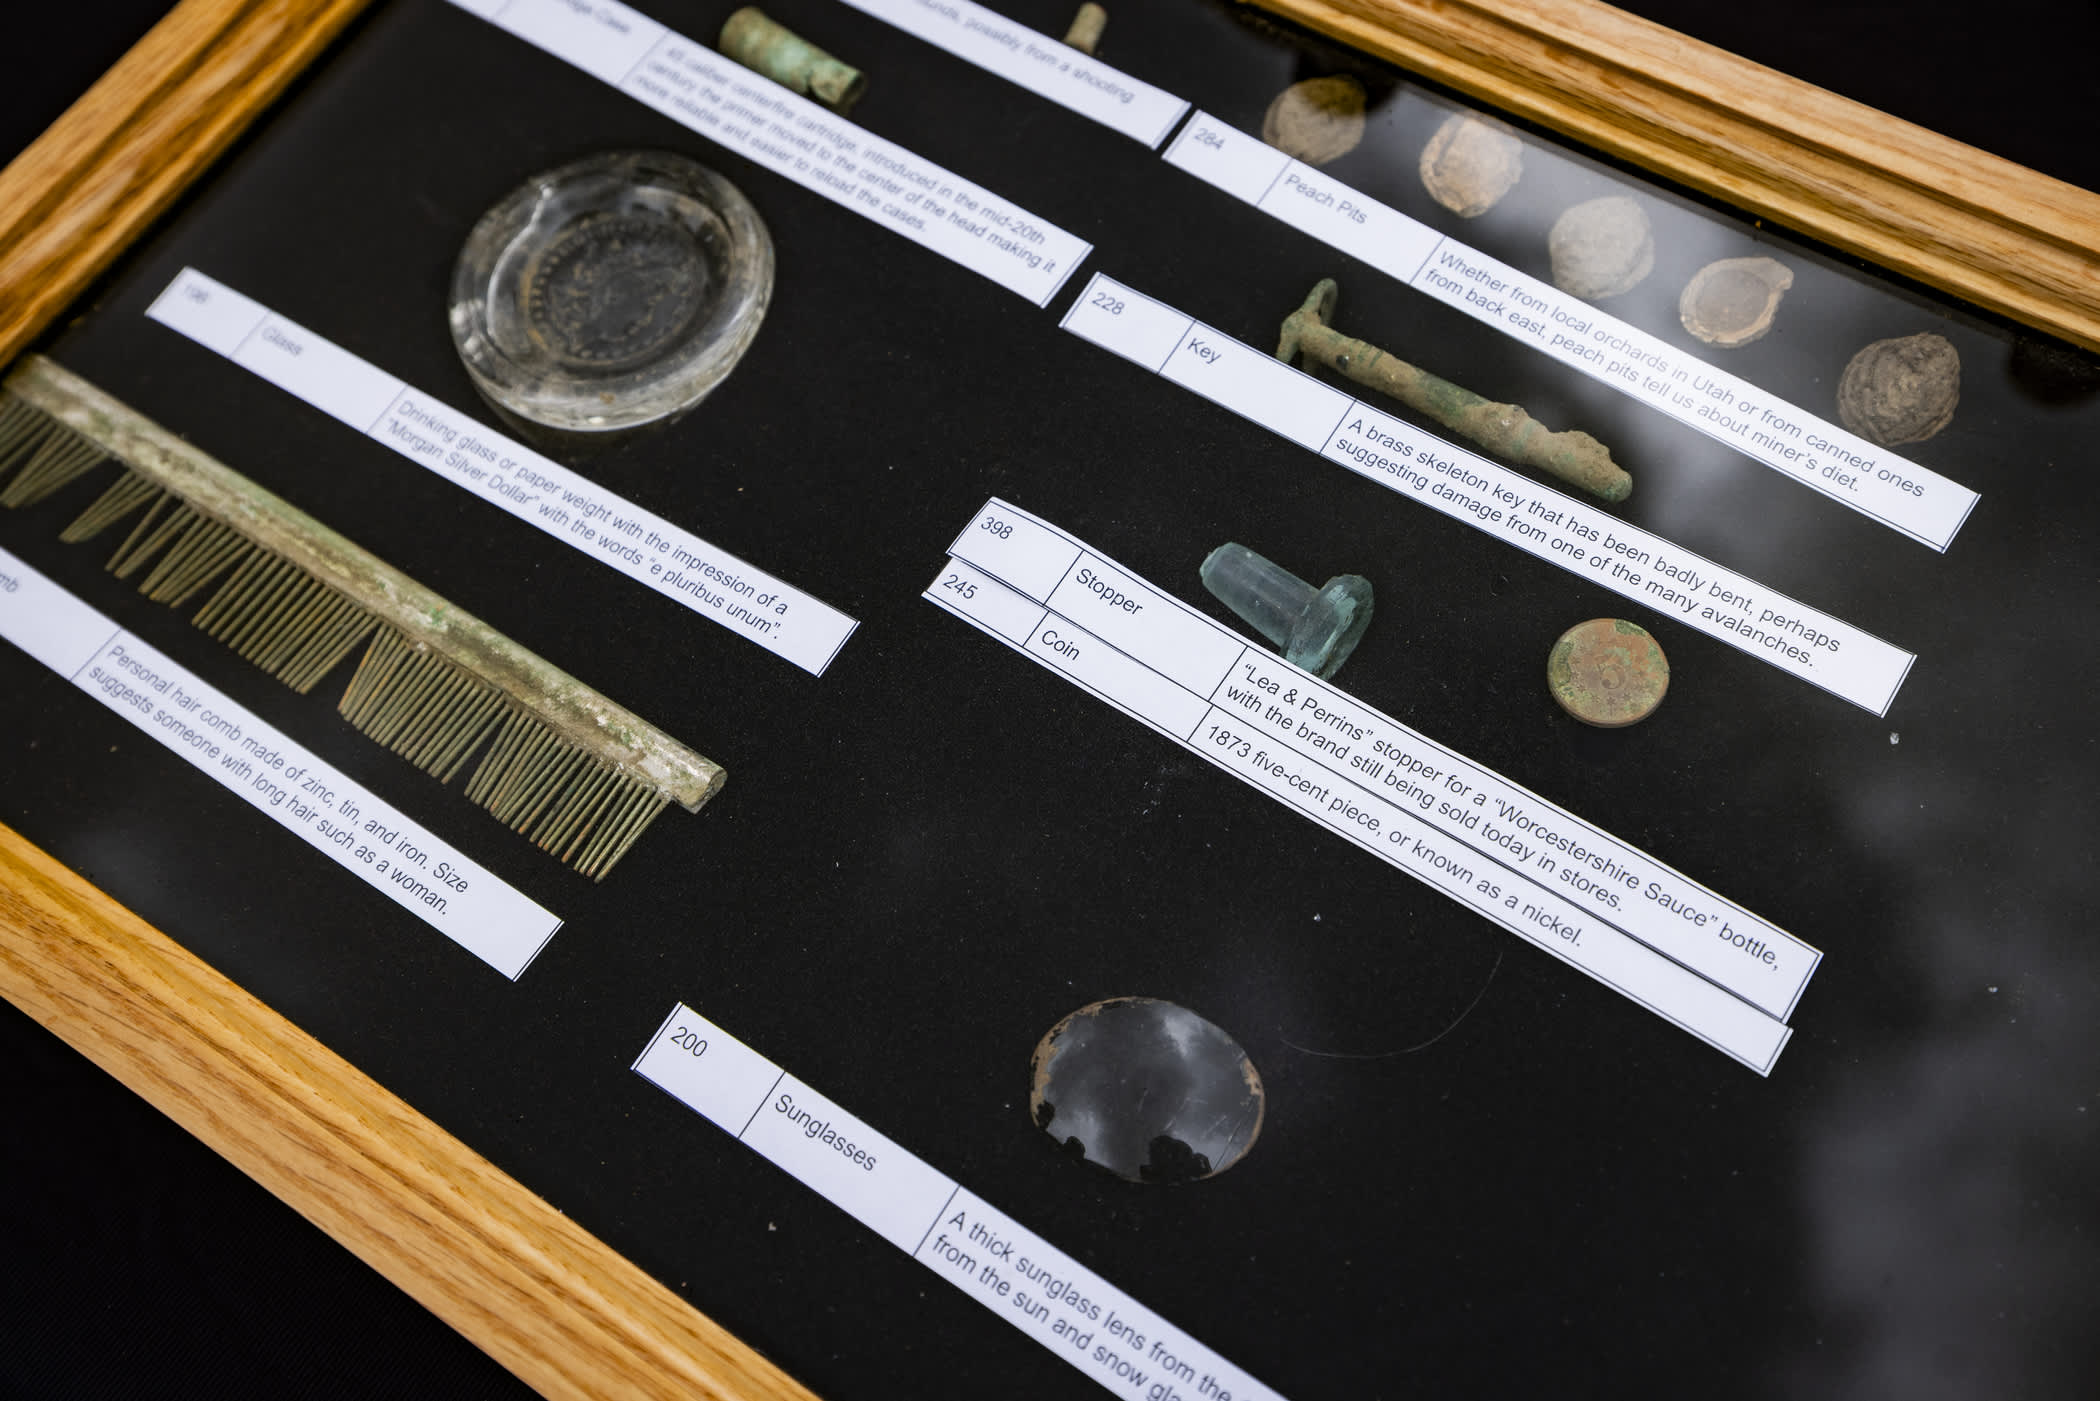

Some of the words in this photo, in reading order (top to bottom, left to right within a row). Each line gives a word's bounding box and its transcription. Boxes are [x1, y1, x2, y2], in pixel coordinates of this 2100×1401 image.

[1194, 128, 1225, 150] 284
[1284, 174, 1335, 207] Peach
[1337, 200, 1367, 224] Pits
[1043, 262, 1056, 273] it
[1091, 292, 1125, 315] 228
[1187, 338, 1221, 364] Key
[1425, 269, 1463, 295] from
[1465, 288, 1505, 317] back
[1508, 312, 1546, 339] east,
[1550, 333, 1605, 365] peach
[1605, 361, 1639, 382] pits
[1642, 376, 1671, 397] tell
[1672, 392, 1694, 409] us
[1697, 405, 1749, 436] about
[1822, 466, 1858, 492] diet.
[1440, 251, 1509, 292] Whether
[1510, 287, 1549, 314] from
[1550, 306, 1593, 335] local
[1593, 330, 1669, 373] orchards
[1671, 368, 1688, 382] in
[1692, 375, 1734, 405] Utah
[1738, 401, 1759, 415] or
[1760, 409, 1802, 438] from
[1806, 435, 1876, 473] canned
[1877, 469, 1924, 497] ones
[397, 400, 458, 443] Drinking
[456, 437, 498, 463] glass
[499, 458, 518, 471] or
[514, 467, 562, 494] paper
[562, 490, 612, 522] weight
[612, 516, 643, 539] with
[644, 532, 670, 553] the
[671, 545, 755, 598] impression
[756, 593, 779, 607] of
[775, 603, 788, 615] a
[445, 452, 488, 481] Silver
[538, 503, 569, 526] with
[570, 519, 596, 540] the
[598, 535, 643, 565] words
[650, 558, 662, 575] “e
[660, 570, 725, 608] pluribus
[726, 603, 781, 639] unum”.
[943, 574, 978, 599] 245
[981, 516, 1013, 540] 398
[1076, 568, 1143, 615] Stopper
[1336, 439, 1429, 491] suggesting
[1432, 483, 1502, 522] damage
[1506, 514, 1547, 543] from
[1551, 538, 1585, 560] one
[1589, 556, 1613, 570] of
[1611, 563, 1641, 586] the
[1645, 581, 1699, 613] many
[1701, 607, 1813, 667] avalanches.
[1347, 419, 1362, 434] A
[1366, 425, 1414, 457] brass
[1416, 452, 1489, 492] skeleton
[1492, 483, 1526, 509] key
[1528, 500, 1564, 526] that
[1565, 516, 1600, 542] has
[1603, 533, 1650, 565] been
[1654, 556, 1706, 591] badly
[1708, 581, 1753, 616] bent,
[1758, 609, 1840, 652] perhaps
[1041, 630, 1080, 661] Coin
[89, 667, 154, 714] suggests
[153, 710, 220, 759] someone
[221, 754, 252, 780] with
[251, 772, 287, 806] long
[285, 795, 319, 823] hair
[316, 820, 355, 850] such
[354, 845, 376, 864] as
[376, 860, 390, 873] a
[390, 867, 447, 915] woman.
[107, 645, 175, 695] Personal
[170, 687, 202, 712] hair
[200, 710, 241, 741] comb
[241, 737, 284, 770] made
[285, 766, 308, 782] of
[300, 777, 335, 808] zinc,
[338, 799, 360, 826] tin,
[364, 820, 400, 845] and
[395, 837, 428, 870] iron.
[433, 862, 468, 893] Size
[1209, 726, 1252, 758] 1873
[1252, 751, 1329, 803] five-cent
[1327, 797, 1381, 837] piece,
[1389, 831, 1411, 847] or
[1411, 839, 1473, 884] known
[1476, 880, 1501, 899] as
[1504, 895, 1519, 909] a
[1522, 904, 1582, 947] nickel.
[1227, 685, 1262, 713] with
[1265, 705, 1293, 730] the
[1295, 722, 1351, 760] brand
[1350, 755, 1384, 779] still
[1383, 769, 1436, 810] being
[1438, 802, 1480, 830] sold
[1481, 822, 1536, 862] today
[1537, 852, 1556, 873] in
[1559, 868, 1621, 912] stores.
[1245, 663, 1280, 695] “Lea
[1283, 688, 1298, 706] &
[1300, 697, 1374, 741] Perrins”
[1373, 740, 1443, 781] stopper
[1444, 774, 1472, 796] for
[1473, 793, 1487, 807] a
[1495, 798, 1640, 889] “Worcestershire
[1644, 882, 1718, 927] Sauce”
[1719, 922, 1778, 970] bottle,
[670, 1026, 708, 1057] 200
[775, 1094, 876, 1171] Sunglasses
[933, 1234, 977, 1274] from
[979, 1266, 1010, 1296] the
[1013, 1292, 1050, 1323] sun
[1052, 1319, 1095, 1350] and
[1093, 1346, 1148, 1387] snow
[948, 1211, 966, 1231] A
[969, 1223, 1014, 1262] thick
[1016, 1257, 1101, 1320] sunglass
[1103, 1311, 1146, 1351] lens
[1149, 1341, 1196, 1383] from
[1197, 1375, 1232, 1401] the
